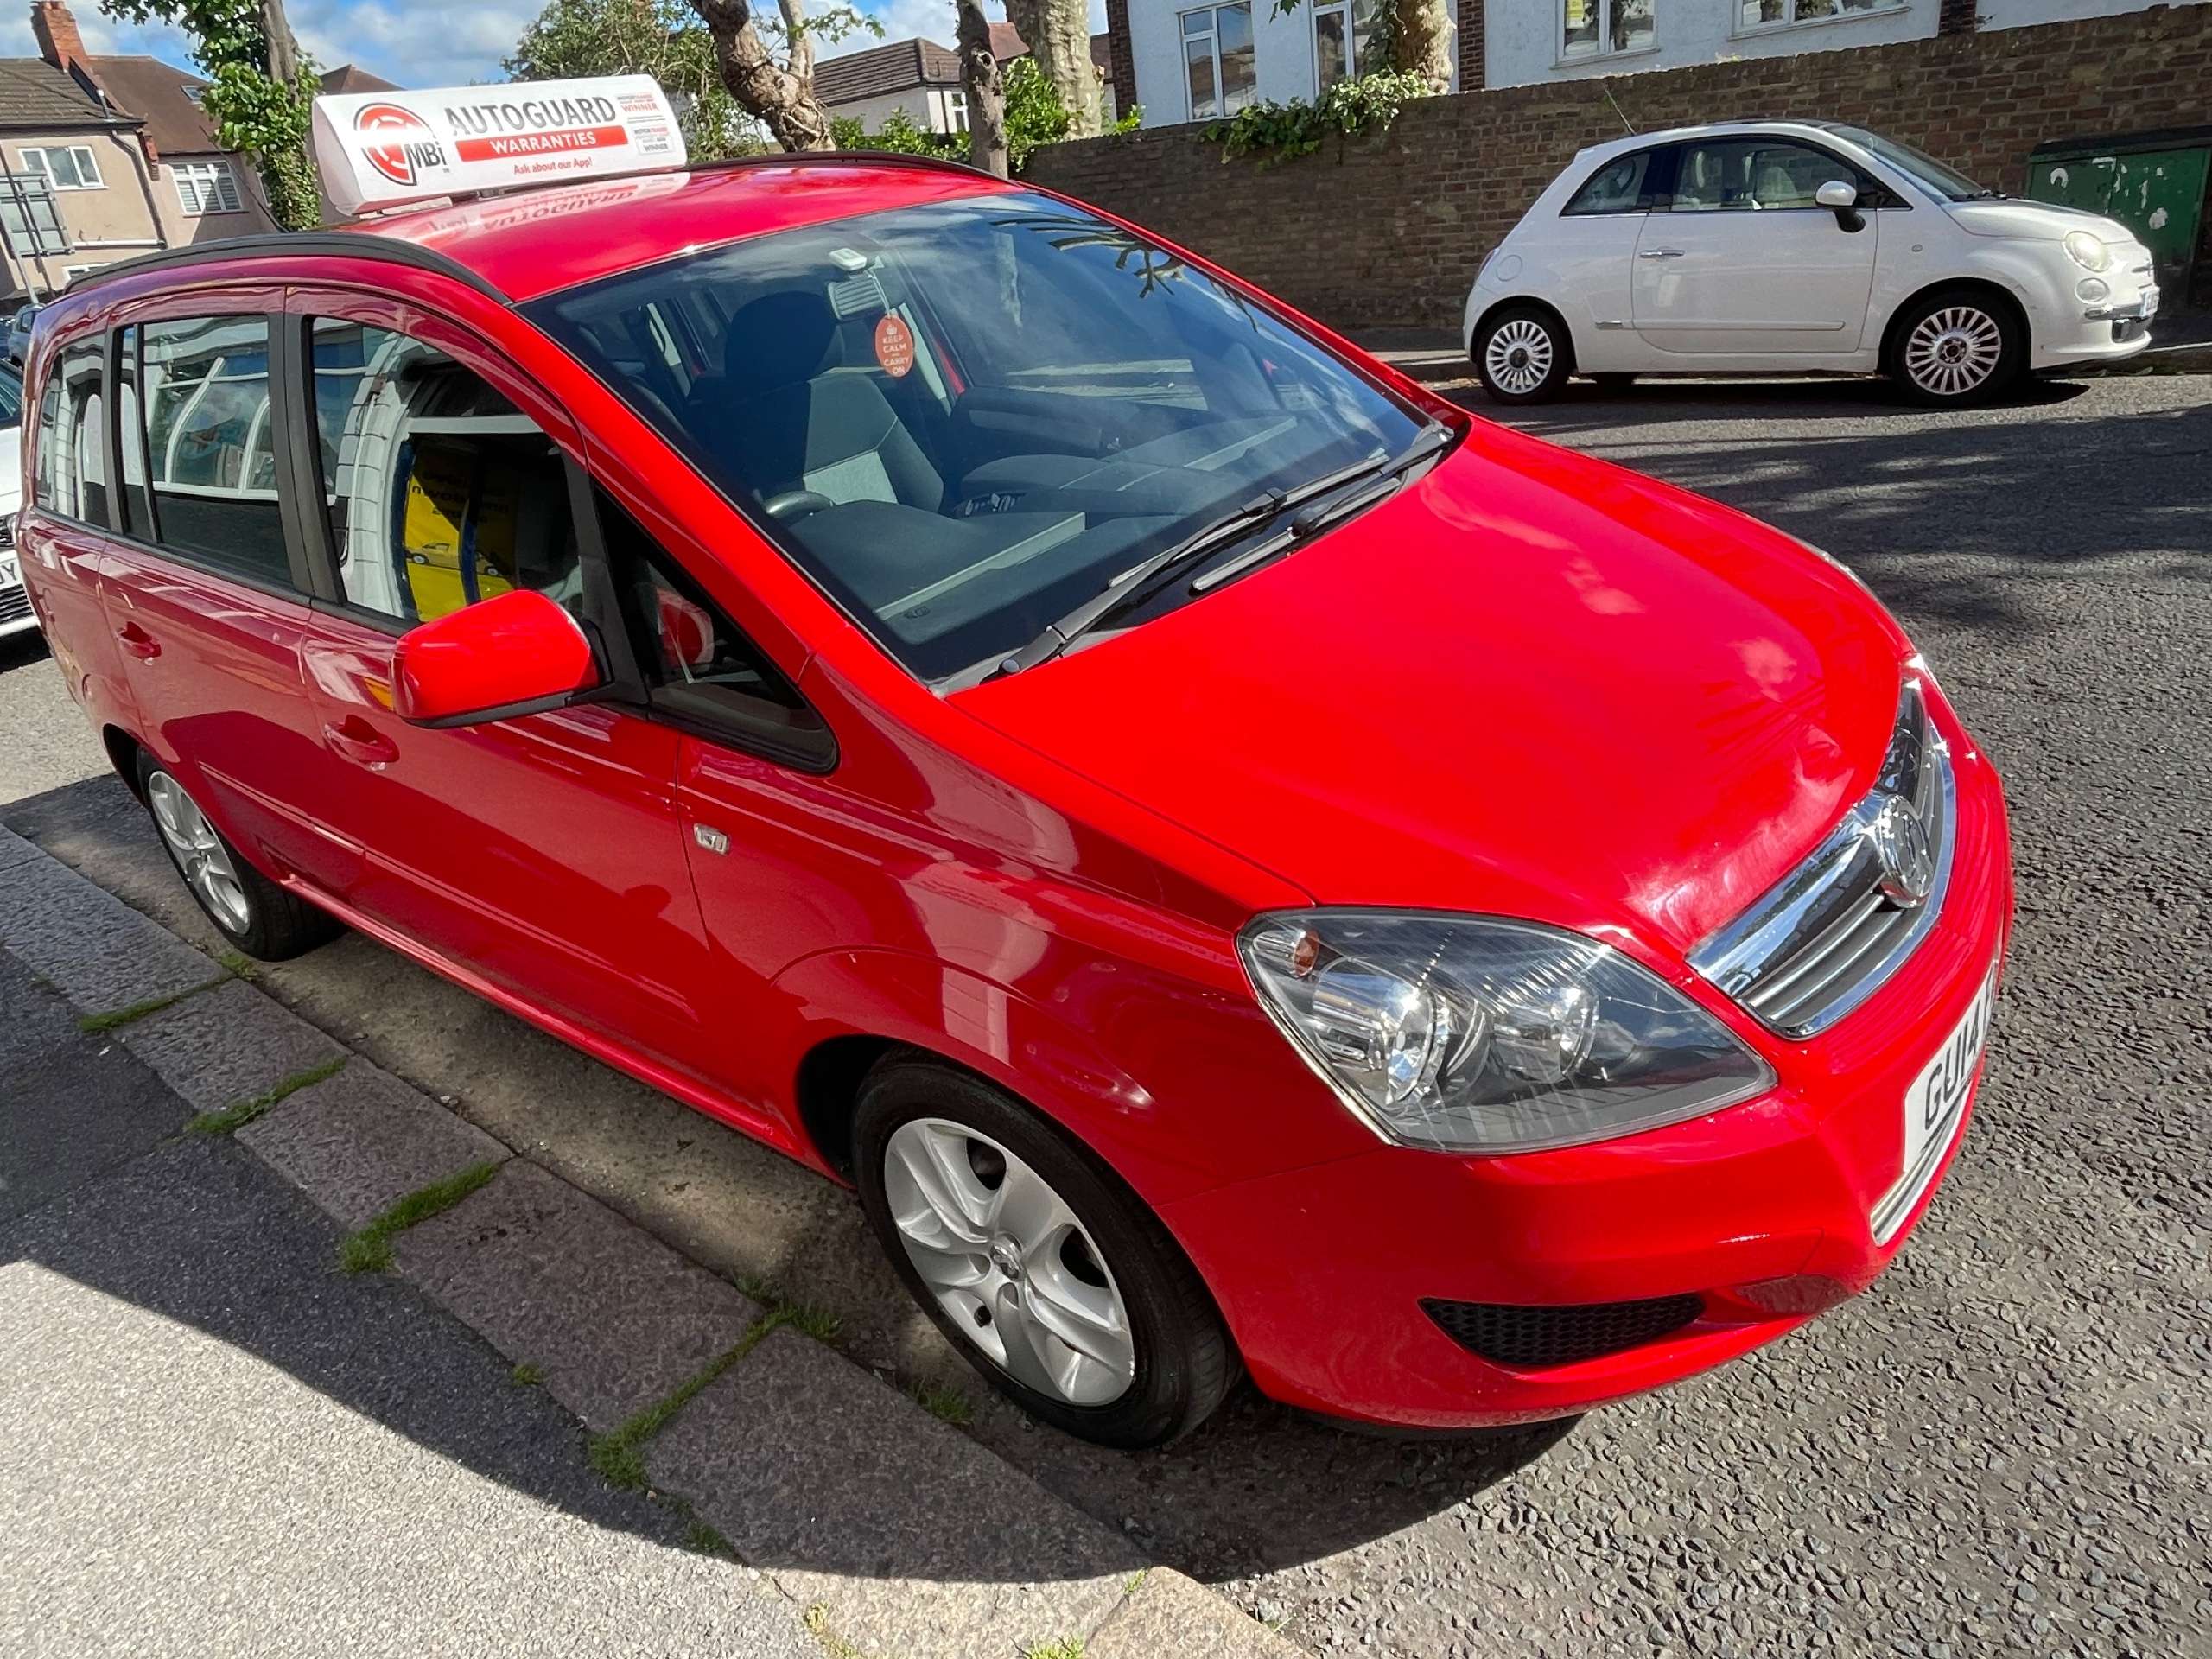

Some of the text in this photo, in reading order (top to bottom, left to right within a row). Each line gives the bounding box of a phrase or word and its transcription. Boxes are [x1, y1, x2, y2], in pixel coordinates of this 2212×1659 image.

[444, 97, 616, 136] AUTOGUARD
[490, 131, 596, 155] WARRANTIES
[513, 156, 593, 175] Ask about our App!
[892, 366, 906, 375] ON
